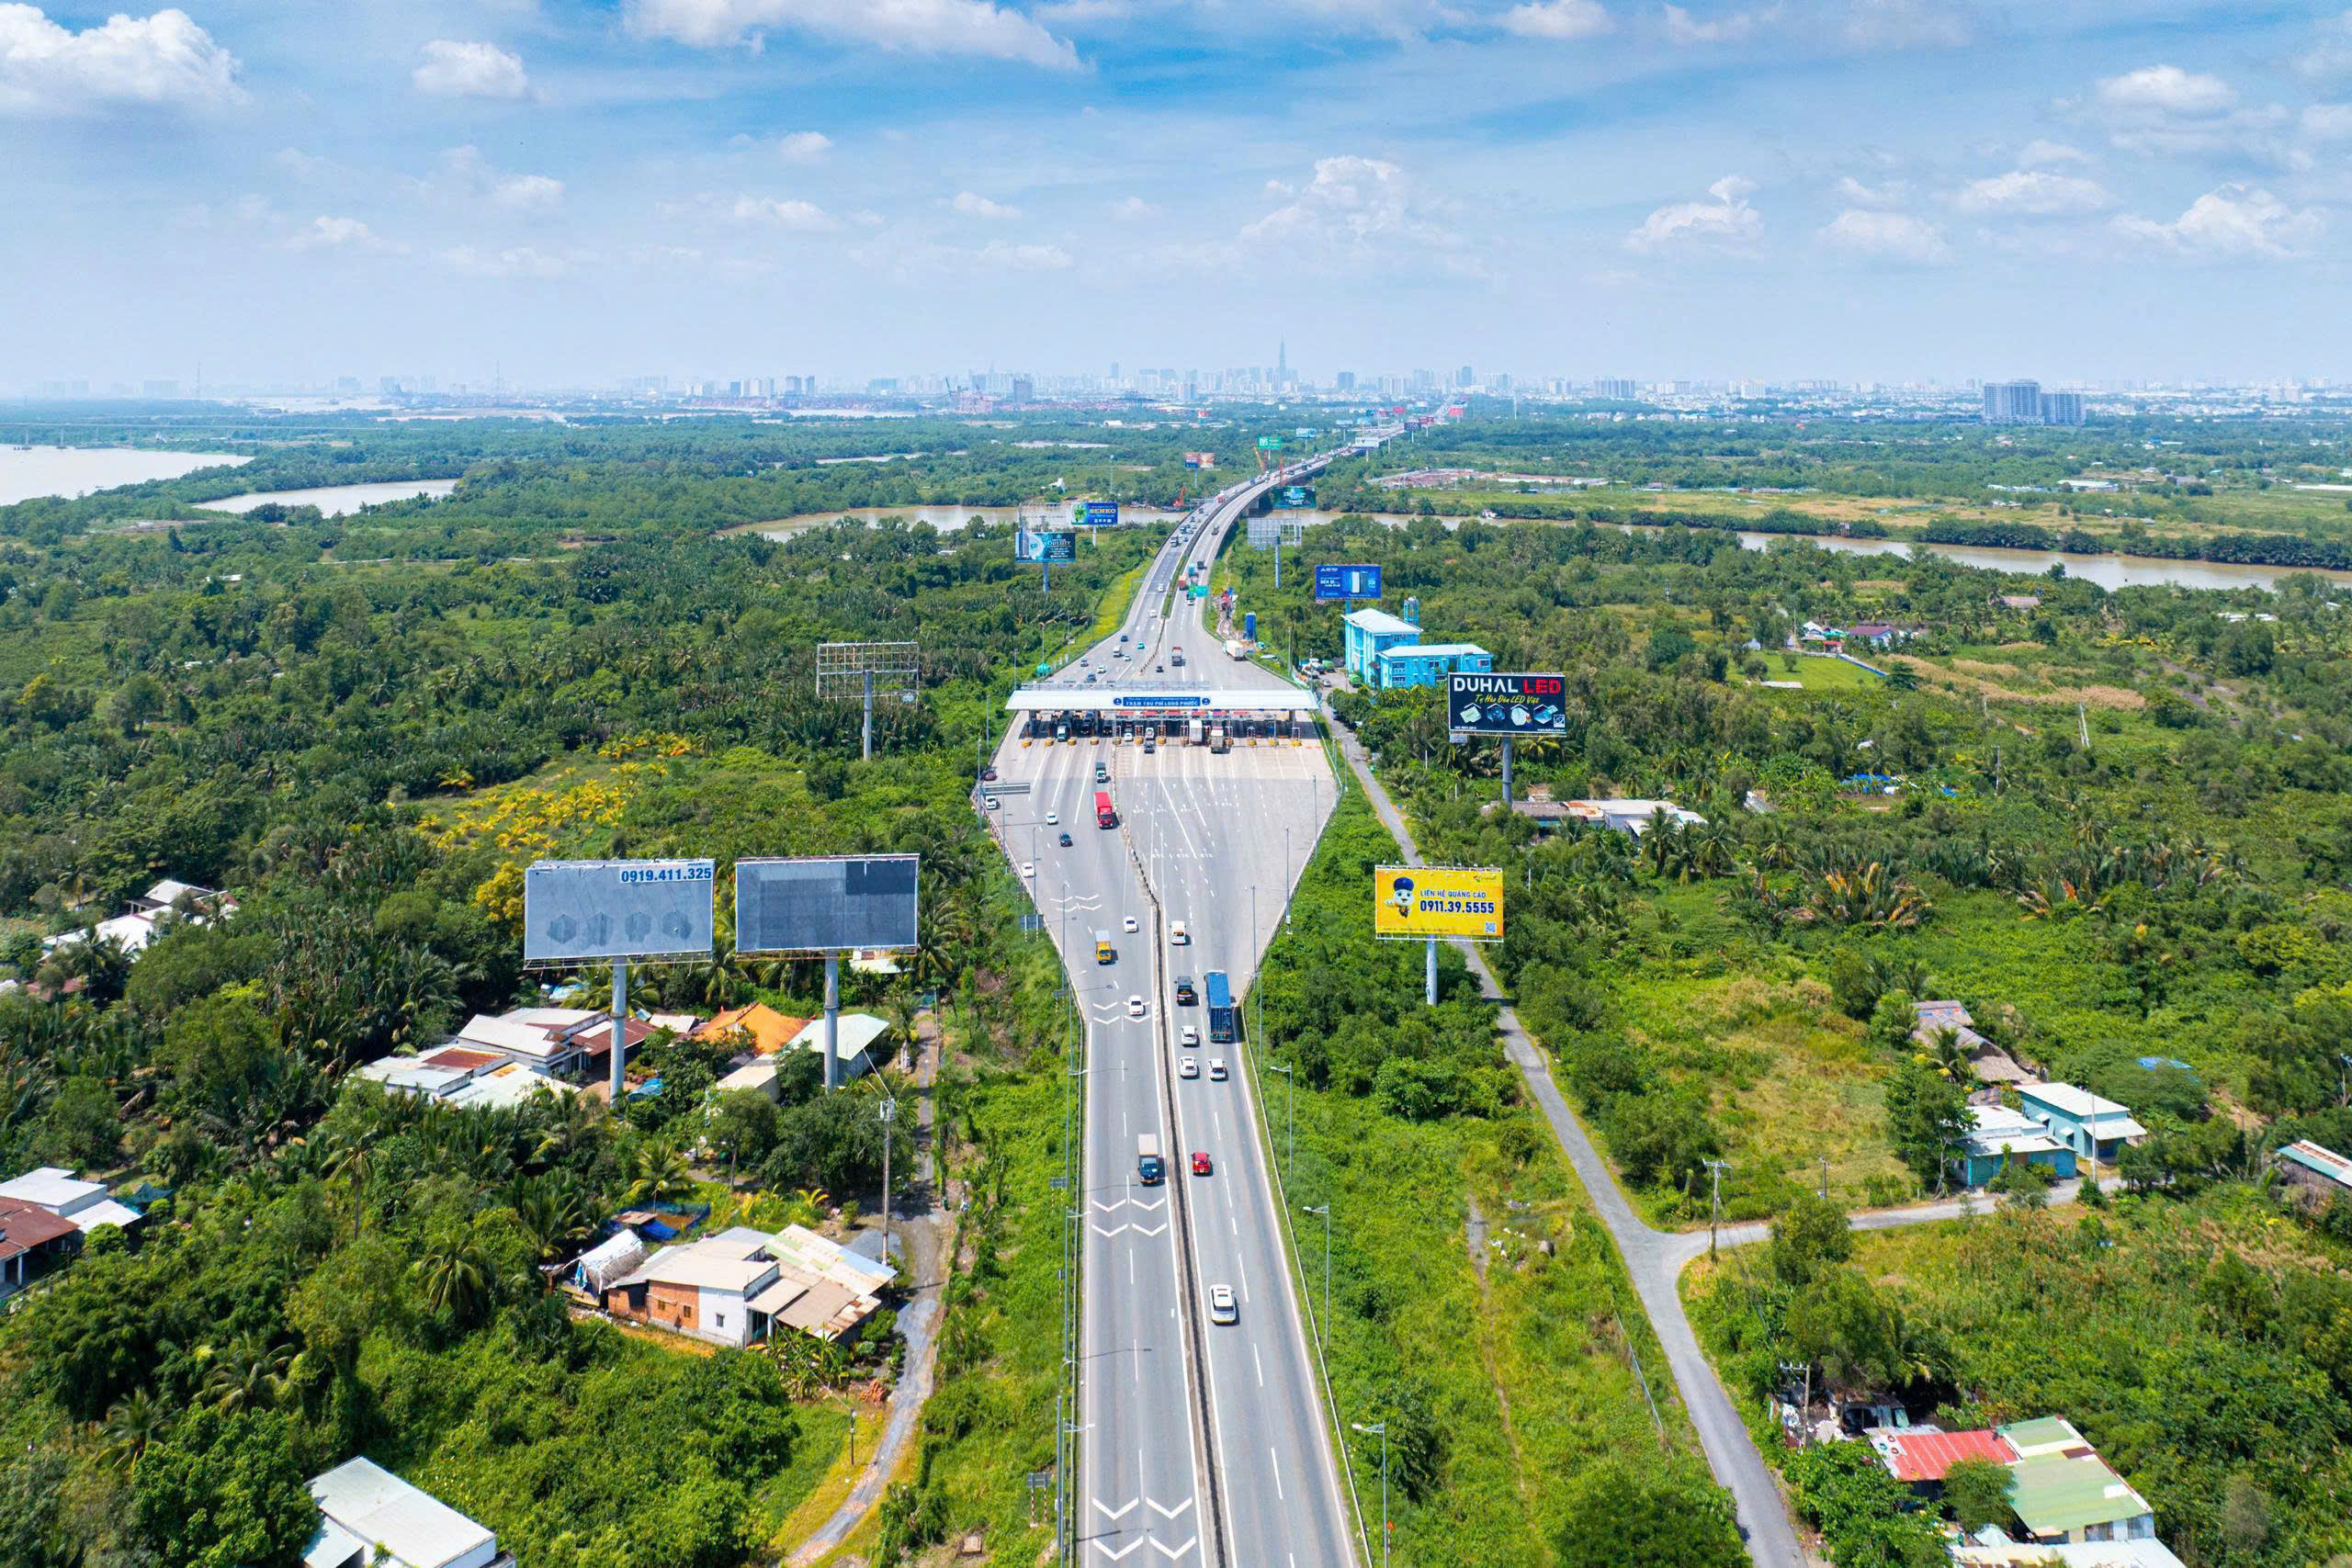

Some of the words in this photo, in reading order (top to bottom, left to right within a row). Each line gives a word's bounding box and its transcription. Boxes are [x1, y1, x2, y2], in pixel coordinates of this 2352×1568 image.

[1453, 677, 1519, 694] DUHAL
[1522, 679, 1561, 694] LED
[1510, 694, 1525, 704] LED
[621, 868, 712, 883] 0919.411.325
[1420, 900, 1495, 913] 0911.39.5555
